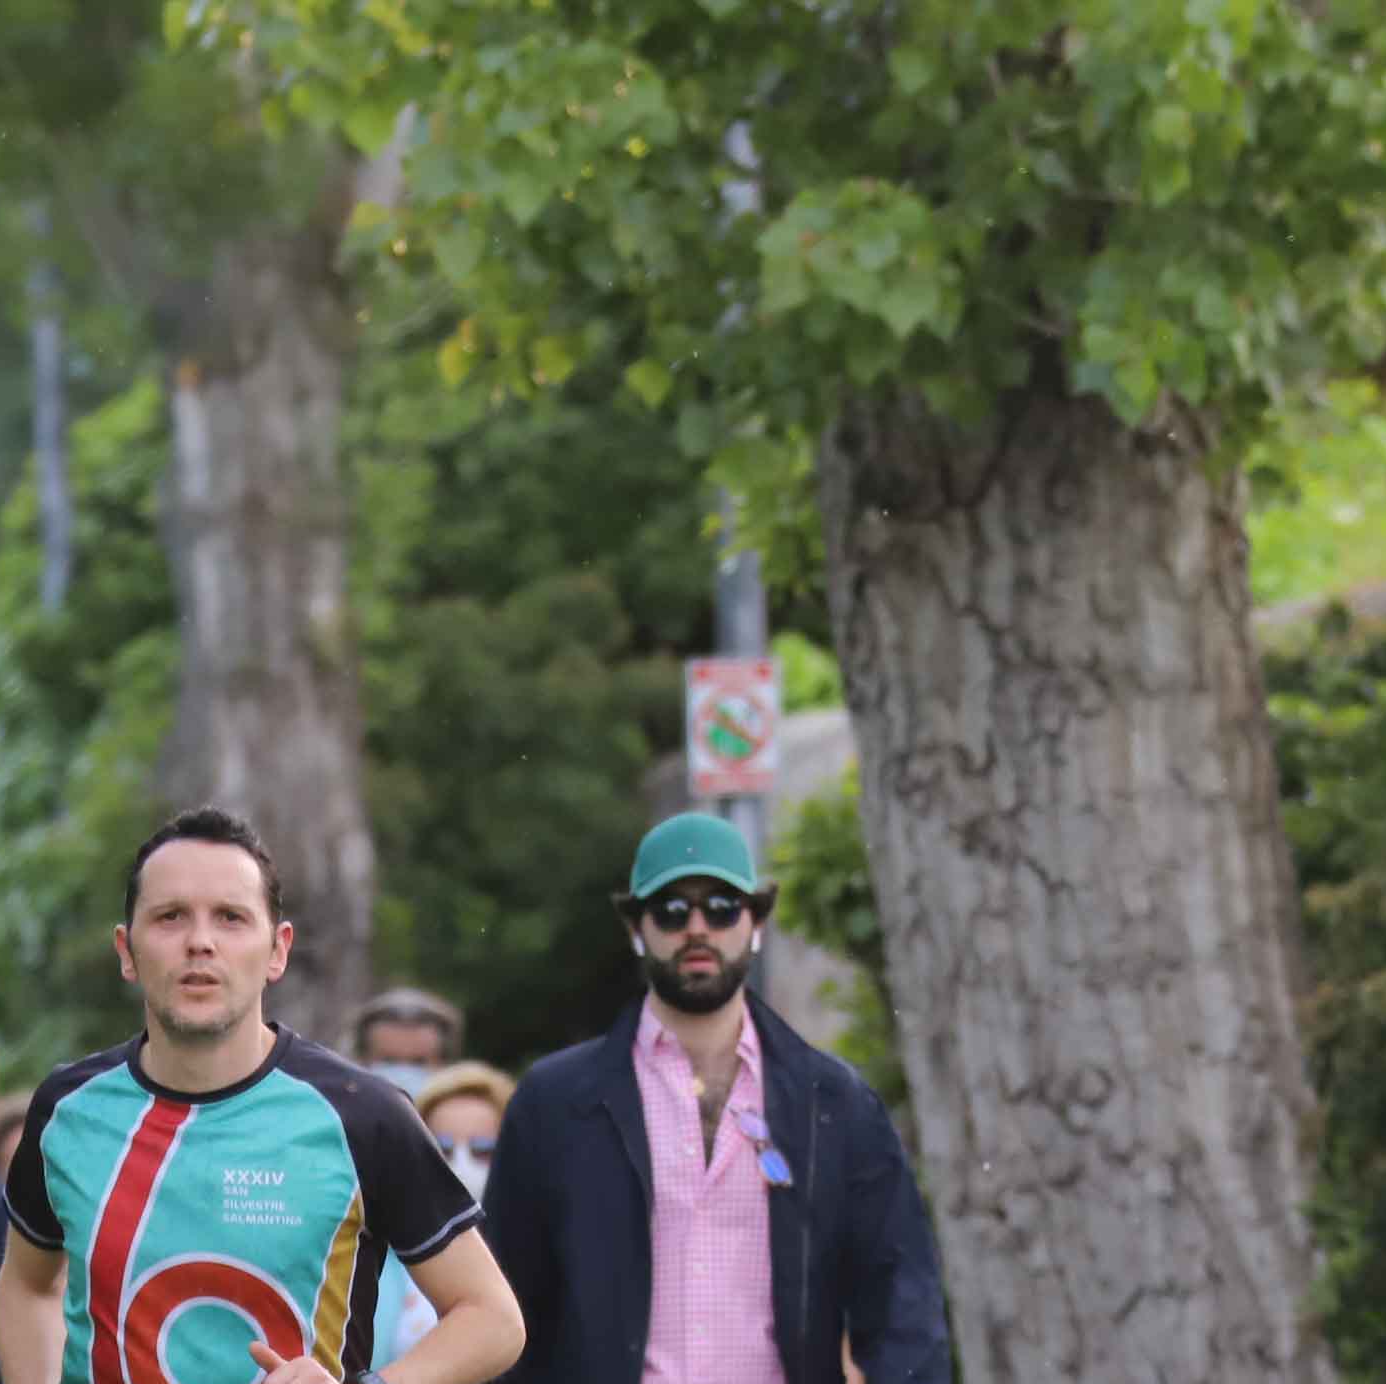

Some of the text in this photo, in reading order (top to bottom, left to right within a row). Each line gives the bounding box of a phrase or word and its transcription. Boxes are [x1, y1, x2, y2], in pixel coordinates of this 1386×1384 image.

[223, 1169, 285, 1185] XXXIV
[223, 1186, 248, 1197] SAN
[223, 1199, 285, 1211] SILVESTRE
[223, 1213, 302, 1225] SALMANTINA
